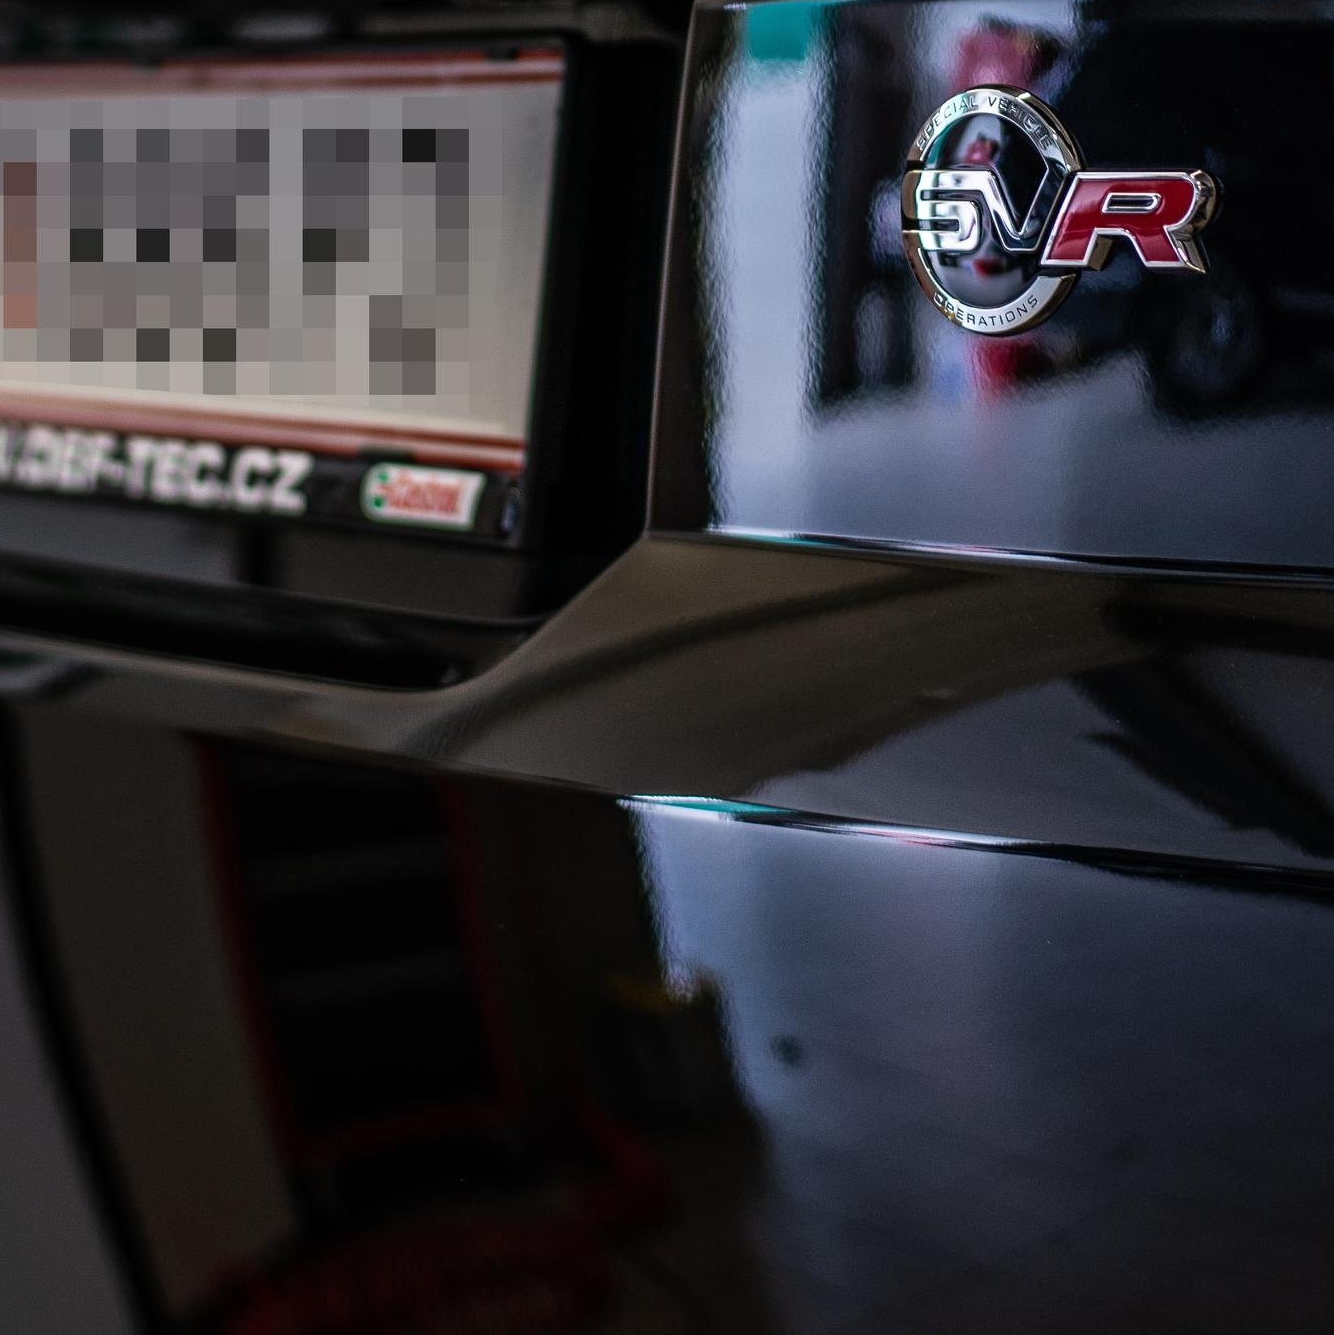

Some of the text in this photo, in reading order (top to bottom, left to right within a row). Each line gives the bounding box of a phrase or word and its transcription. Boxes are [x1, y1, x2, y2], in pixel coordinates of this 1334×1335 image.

[917, 96, 1053, 151] SPECIAL VEHICLE
[901, 168, 1220, 274] SVR
[933, 292, 1038, 327] OPERATIONS
